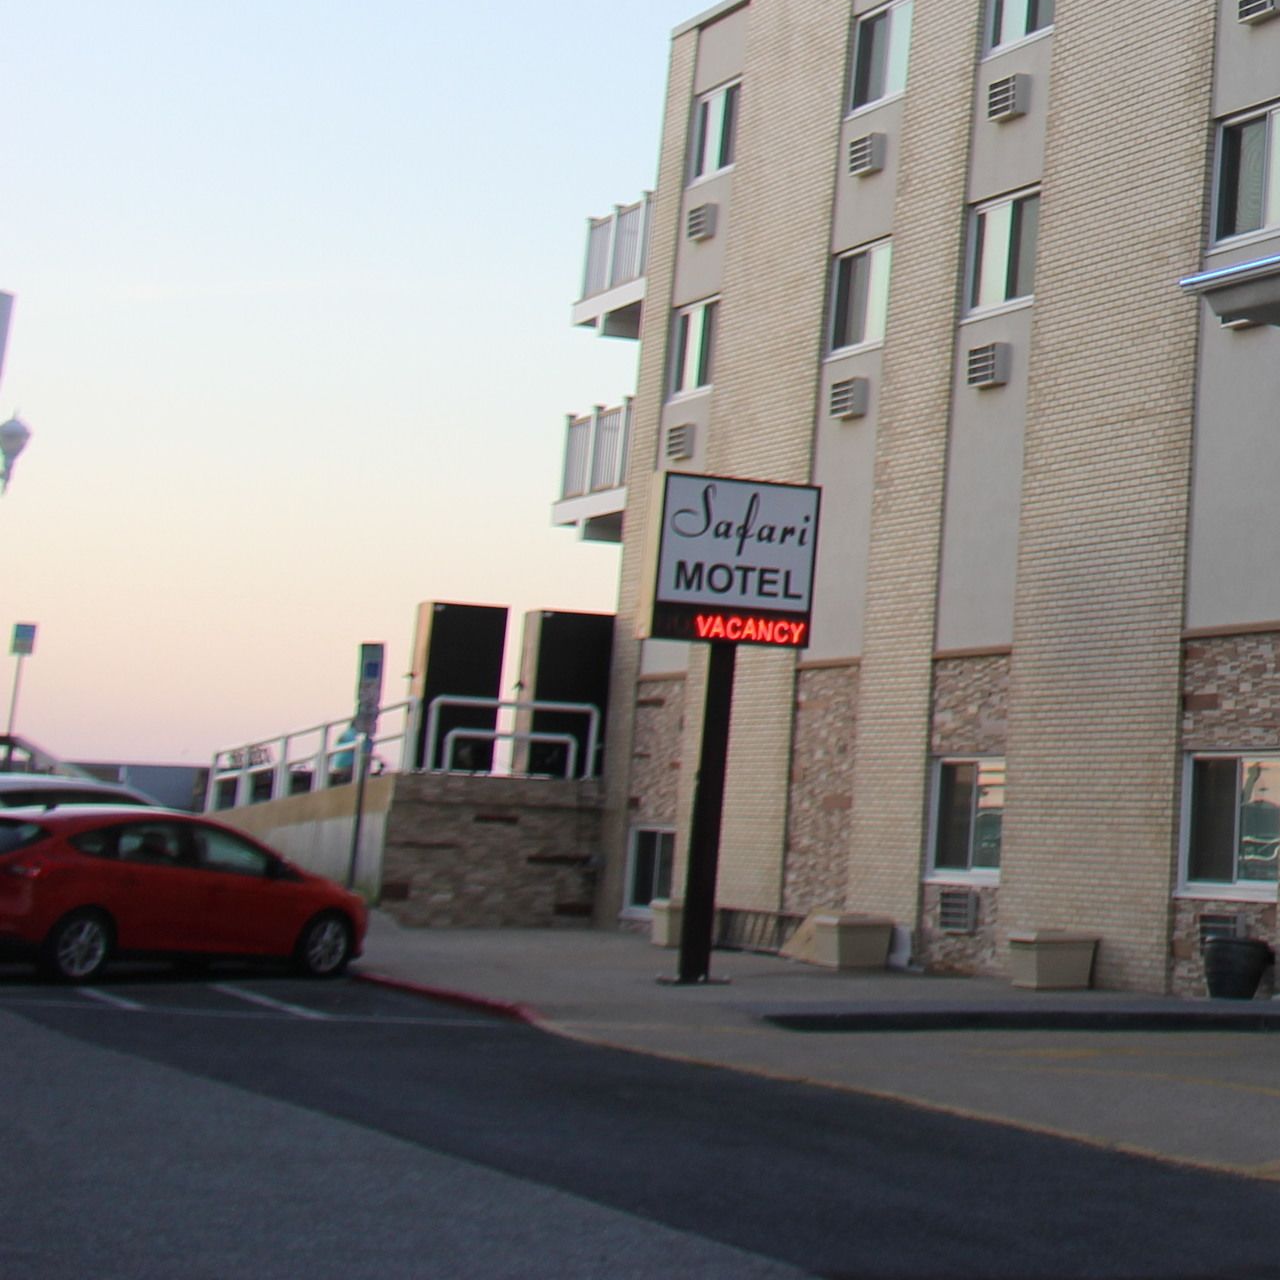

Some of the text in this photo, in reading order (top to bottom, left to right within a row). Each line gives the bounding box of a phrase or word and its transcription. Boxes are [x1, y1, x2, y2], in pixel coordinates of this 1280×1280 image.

[671, 483, 810, 557] Safari
[674, 560, 803, 600] MOTEL
[695, 614, 805, 644] VACANCY
